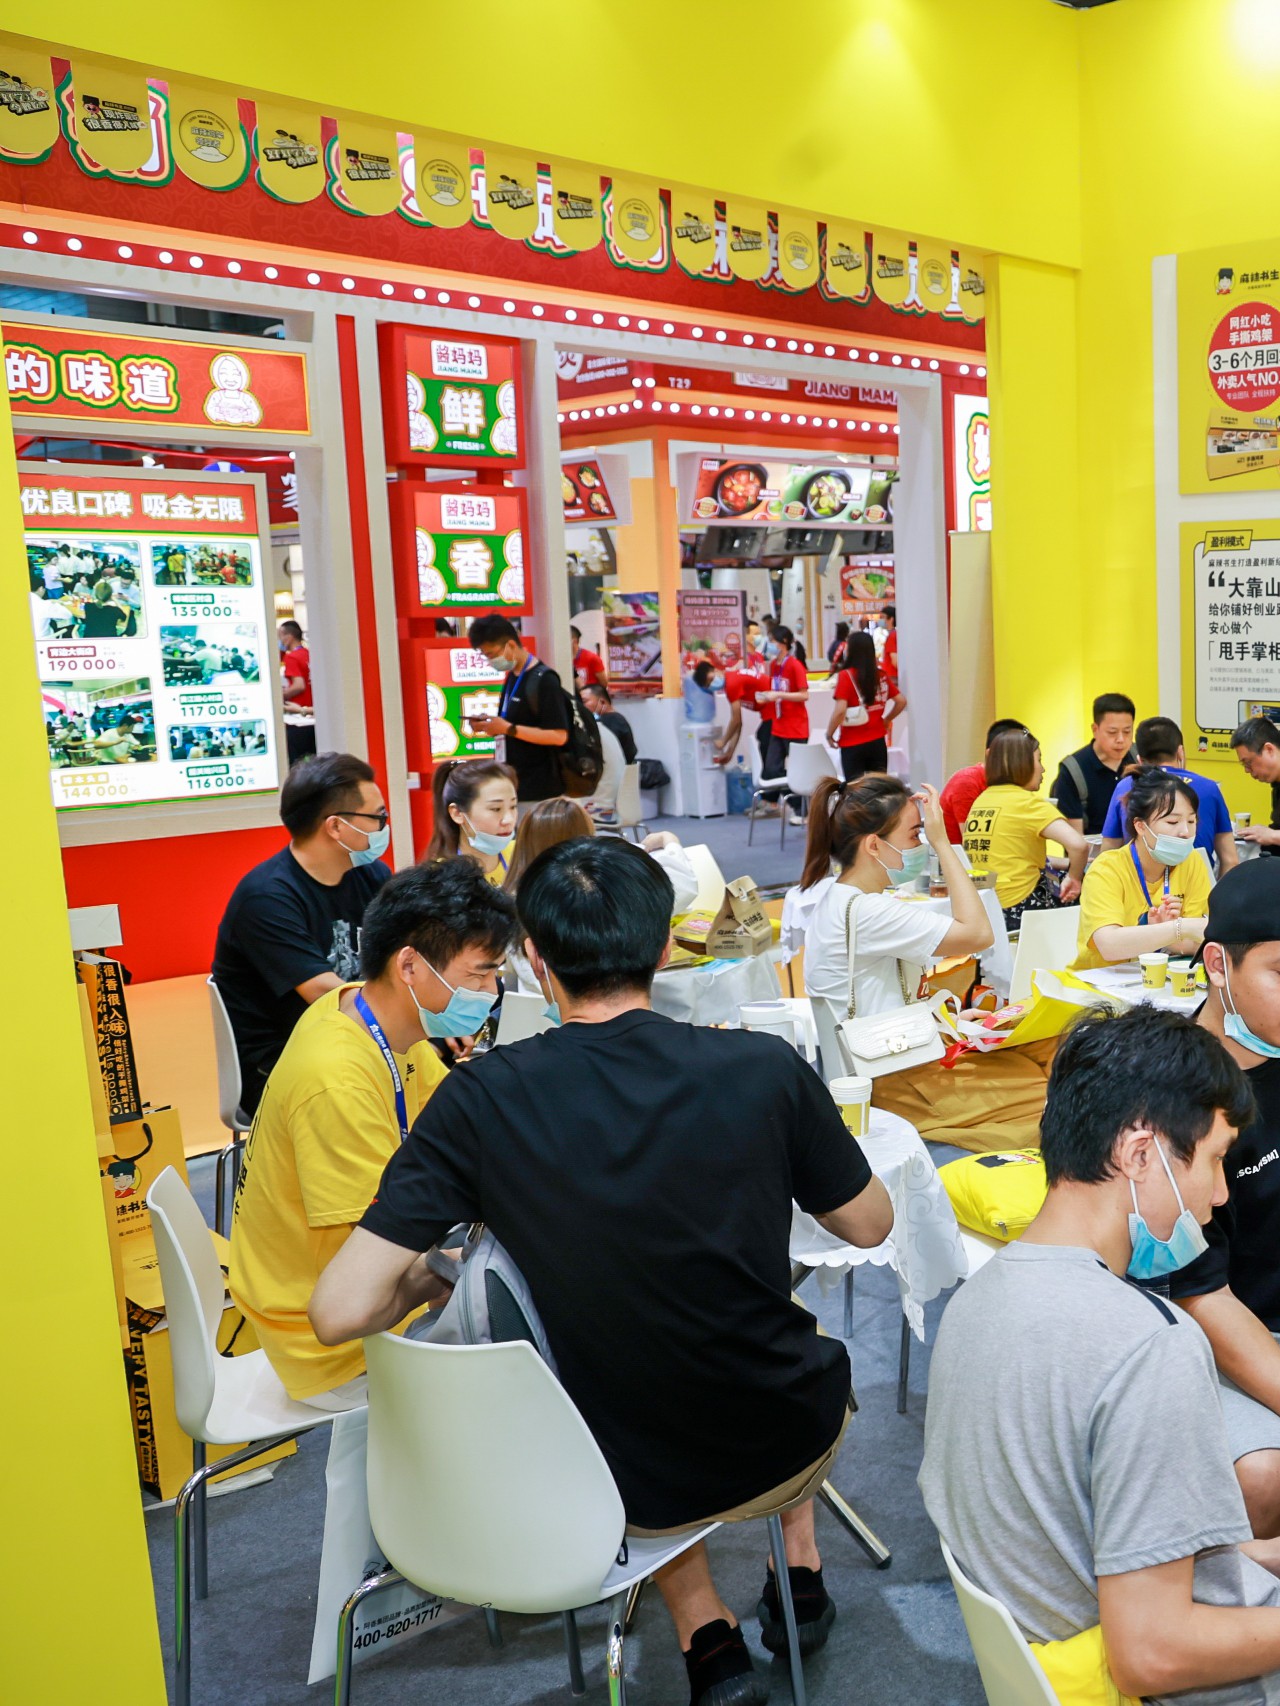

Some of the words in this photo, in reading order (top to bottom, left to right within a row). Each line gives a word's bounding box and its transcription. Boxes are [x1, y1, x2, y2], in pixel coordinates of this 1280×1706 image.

[1229, 312, 1271, 331] 网红小吃
[1228, 328, 1273, 346] 手撕鸡架
[436, 345, 483, 366] 酱妈妈
[5, 352, 172, 406] 的味道
[437, 365, 458, 375] JIANG
[460, 367, 483, 377] MAMA
[668, 376, 691, 389] T29
[805, 381, 850, 399] JIANG
[442, 387, 485, 435] 鲜
[453, 441, 480, 450] FRESH
[20, 489, 132, 518] 优良口碑
[142, 494, 244, 520] 吸金无限
[445, 498, 490, 517] 酱妈妈
[1210, 536, 1244, 548] 盈利模式
[450, 540, 493, 588] 香
[451, 593, 496, 602] FRAGRANT
[1208, 621, 1253, 635] 安心做个
[455, 652, 493, 671] 酱妈
[130, 1331, 147, 1378] VERY
[134, 1387, 151, 1447] TASTY
[354, 1603, 443, 1650] 400-820-1717
